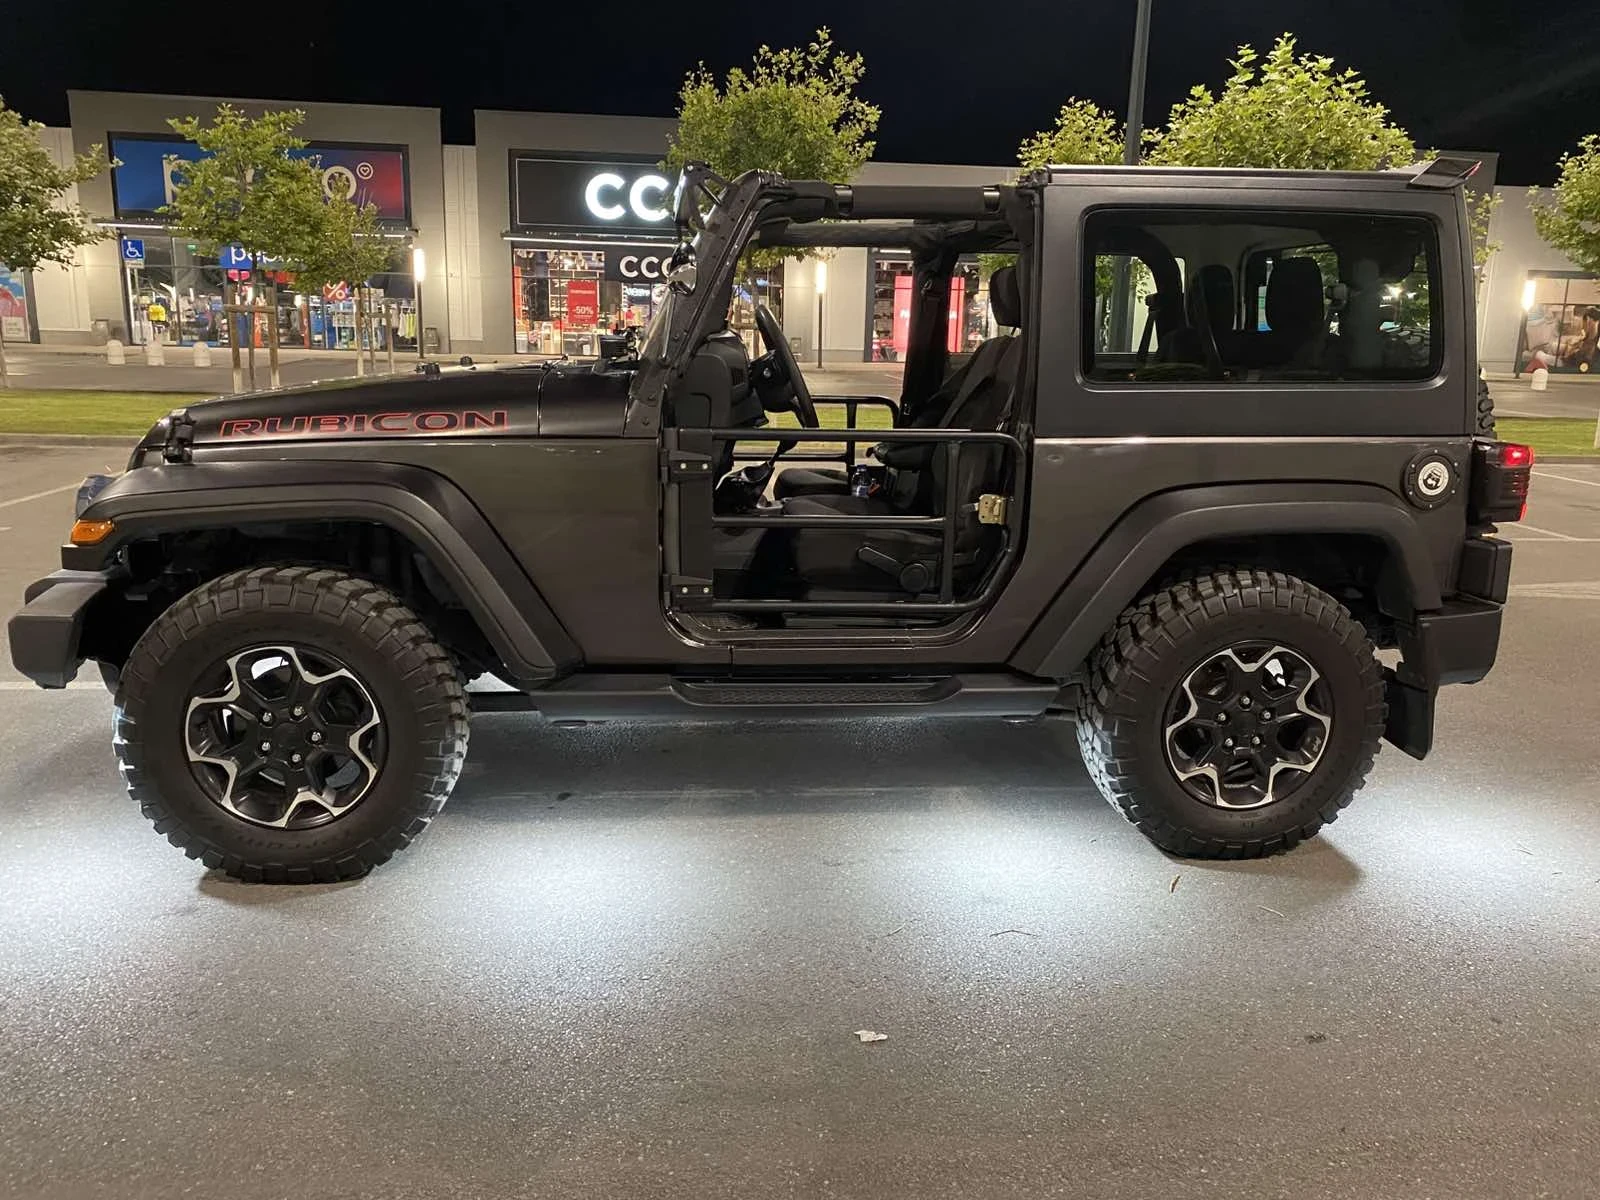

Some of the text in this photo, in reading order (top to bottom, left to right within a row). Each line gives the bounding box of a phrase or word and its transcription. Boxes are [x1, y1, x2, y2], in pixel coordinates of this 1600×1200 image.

[585, 173, 669, 221] CC
[571, 305, 594, 315] -50%
[219, 410, 509, 438] RUBICON
